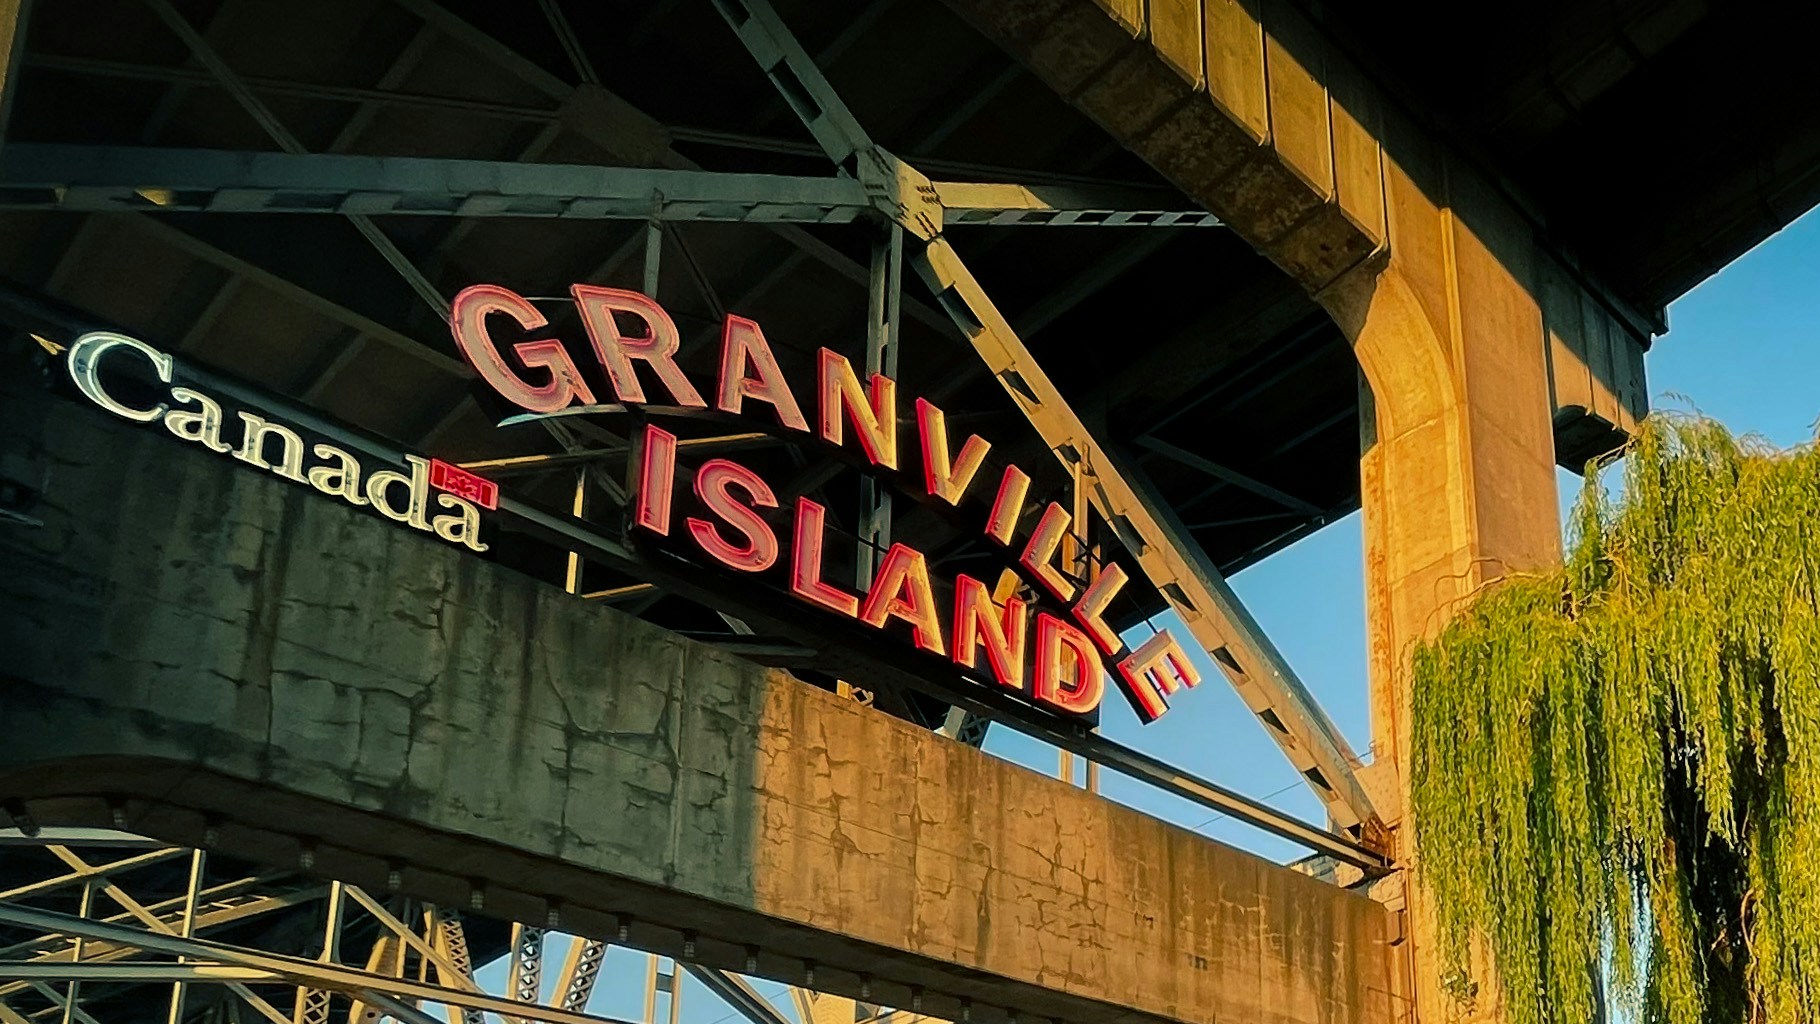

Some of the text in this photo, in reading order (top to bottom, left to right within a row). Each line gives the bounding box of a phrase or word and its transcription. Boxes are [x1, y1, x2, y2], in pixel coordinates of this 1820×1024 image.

[67, 331, 489, 552] Canada
[451, 283, 1202, 724] GRANVILLE
[635, 423, 1105, 715] ISLAND
